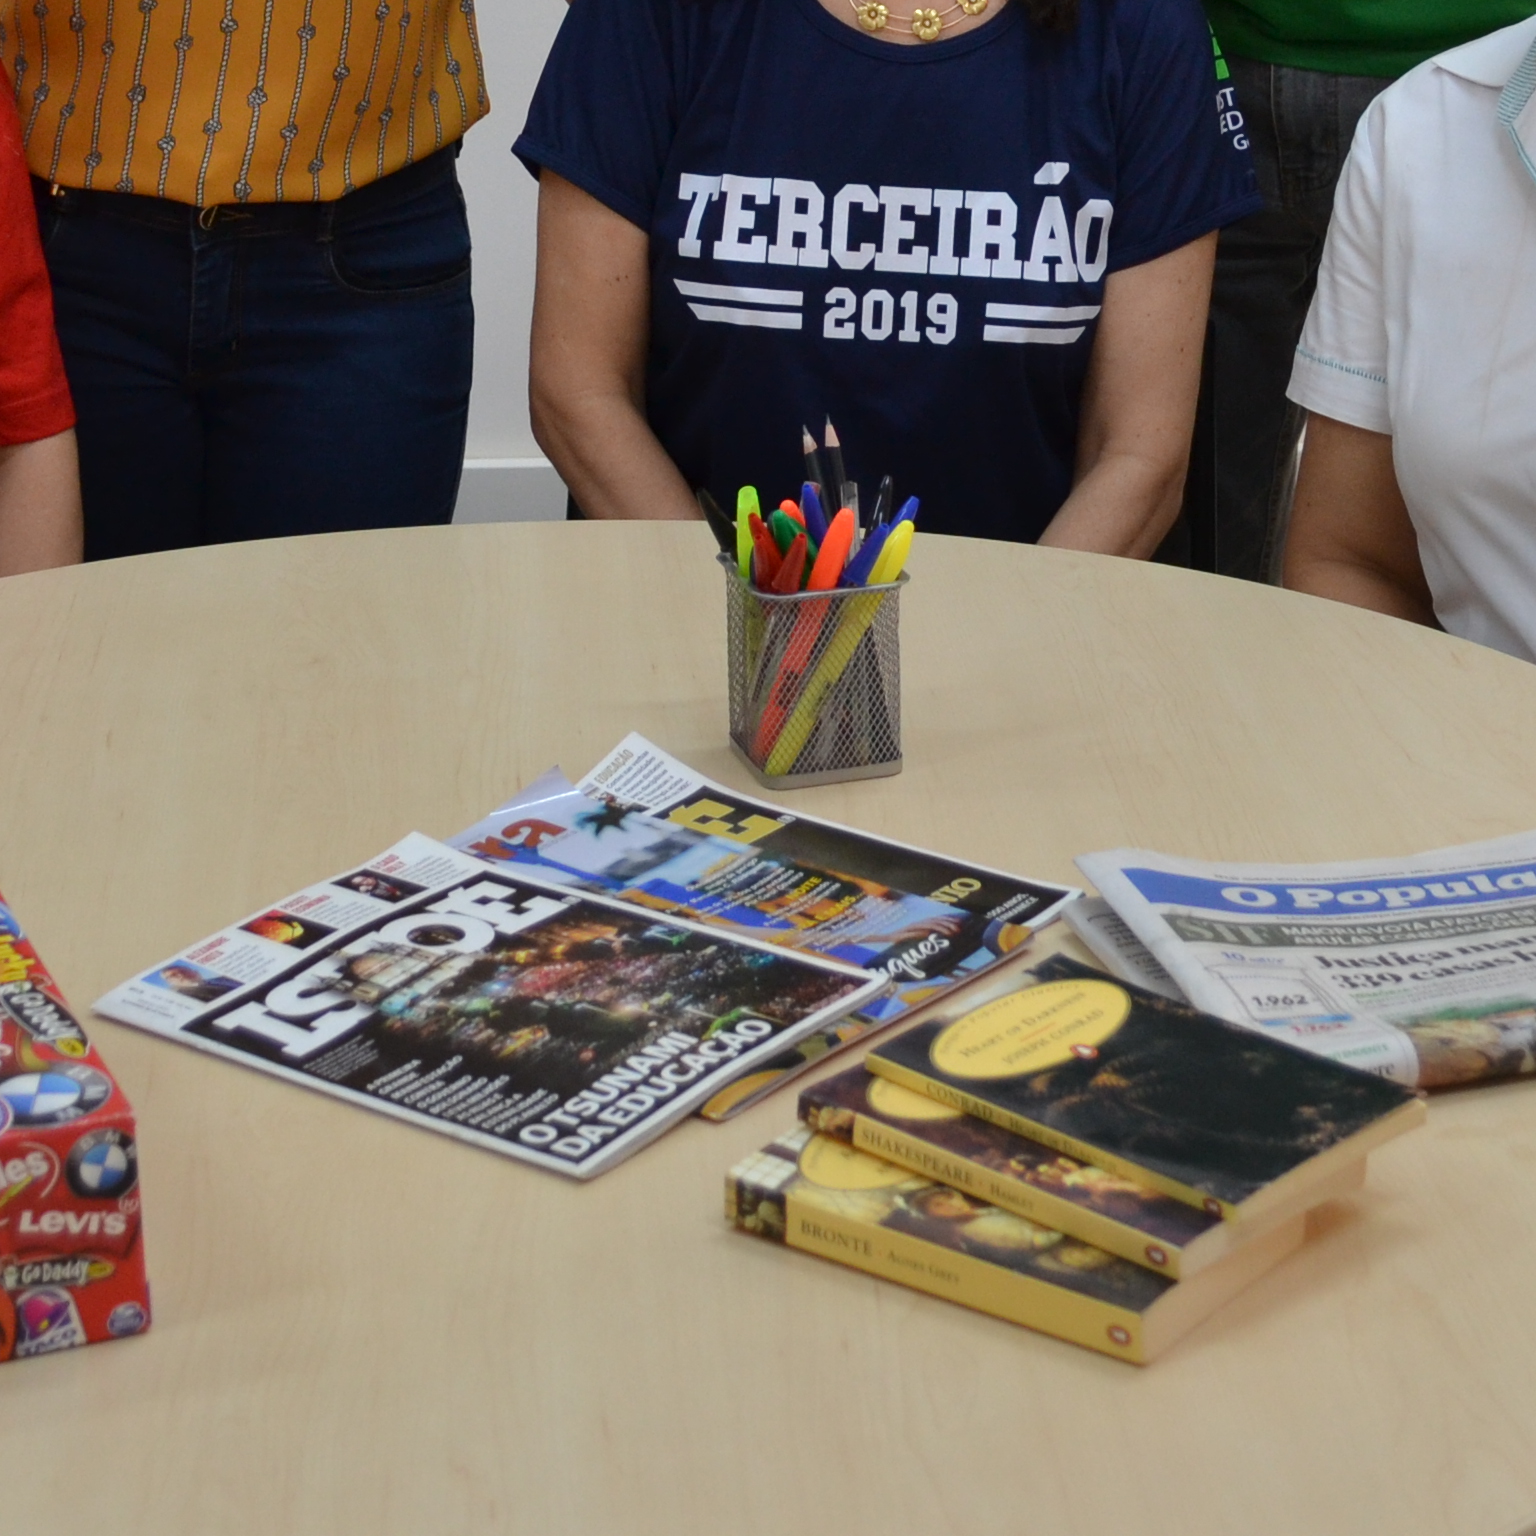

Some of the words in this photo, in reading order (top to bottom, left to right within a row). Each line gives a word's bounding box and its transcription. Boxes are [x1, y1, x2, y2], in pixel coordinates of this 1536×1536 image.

[823, 286, 958, 345] 2019
[1221, 886, 1277, 907] O
[1313, 945, 1450, 972] Justiça
[1407, 956, 1510, 982] casas
[519, 1122, 558, 1145] O
[553, 1031, 699, 1128] TSUNAMI
[551, 1119, 618, 1158] DA
[610, 1018, 773, 1124] EDUCAÇÃO
[862, 1124, 974, 1189] SHAKESPEARE
